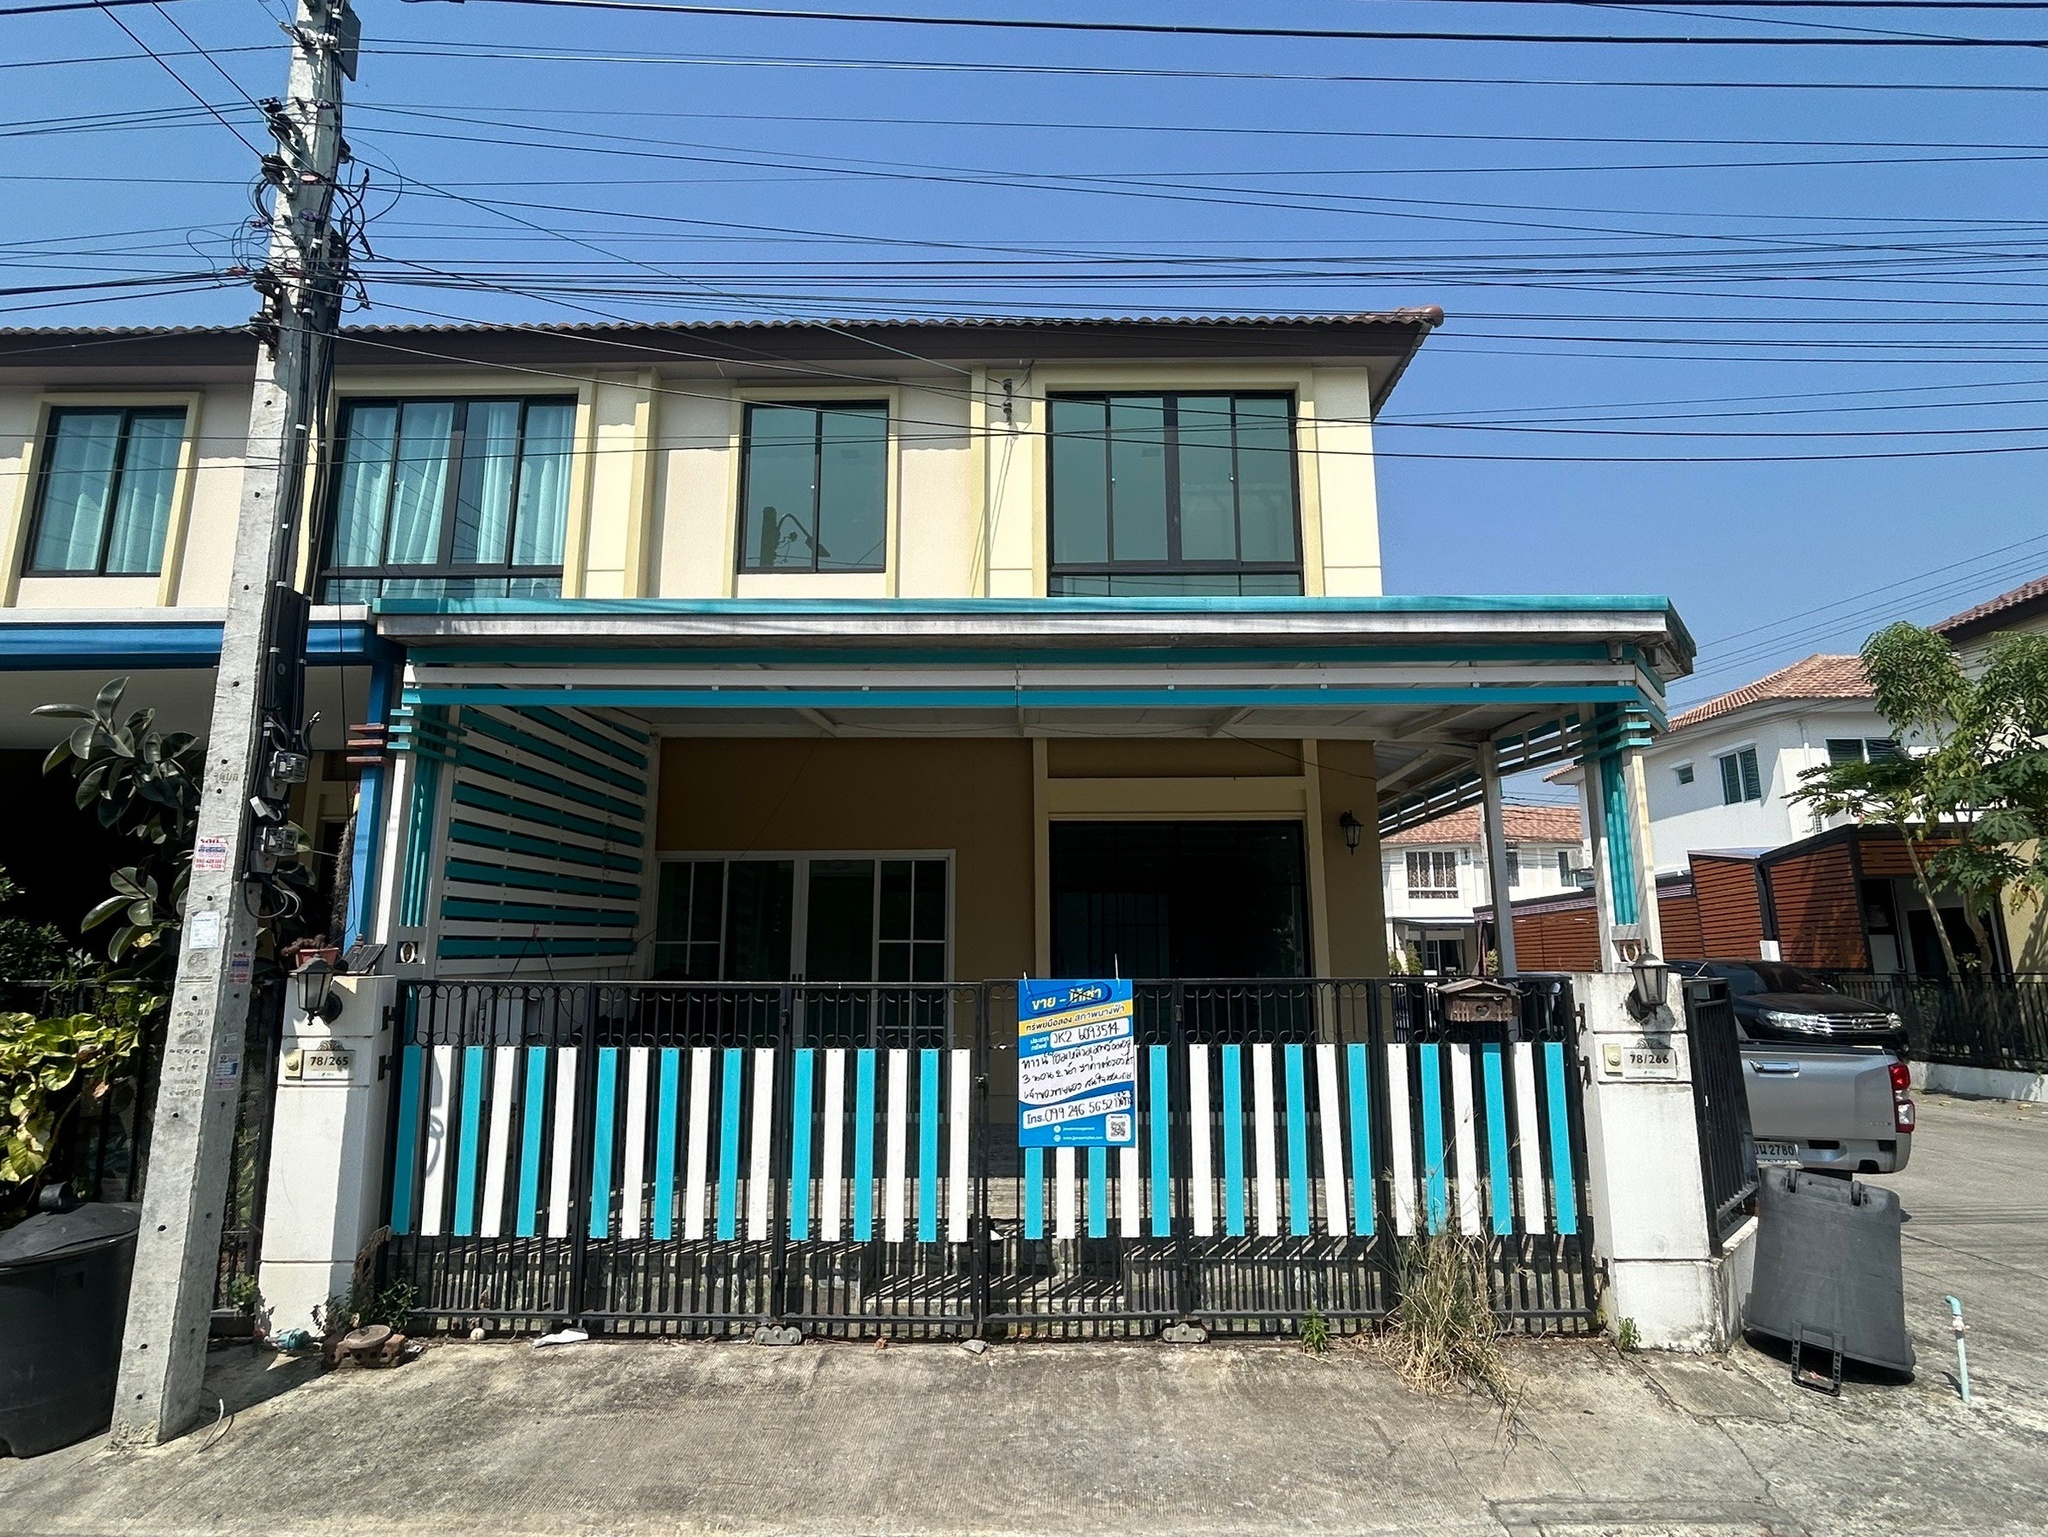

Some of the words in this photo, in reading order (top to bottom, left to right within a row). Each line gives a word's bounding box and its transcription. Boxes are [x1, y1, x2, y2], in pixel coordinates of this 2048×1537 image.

[1032, 996, 1056, 1010] ขาย
[1026, 1015, 1072, 1031] ทรัพย์มือสอง
[1074, 1003, 1125, 1021] สภาพนางฟ้า
[310, 1056, 349, 1066] 78/265
[1629, 1054, 1669, 1064] 78/266
[1022, 1074, 1031, 1084] 3
[1056, 1070, 1063, 1078] 2
[1027, 1113, 1045, 1124] โทร.
[1769, 1144, 1794, 1156] 2780
